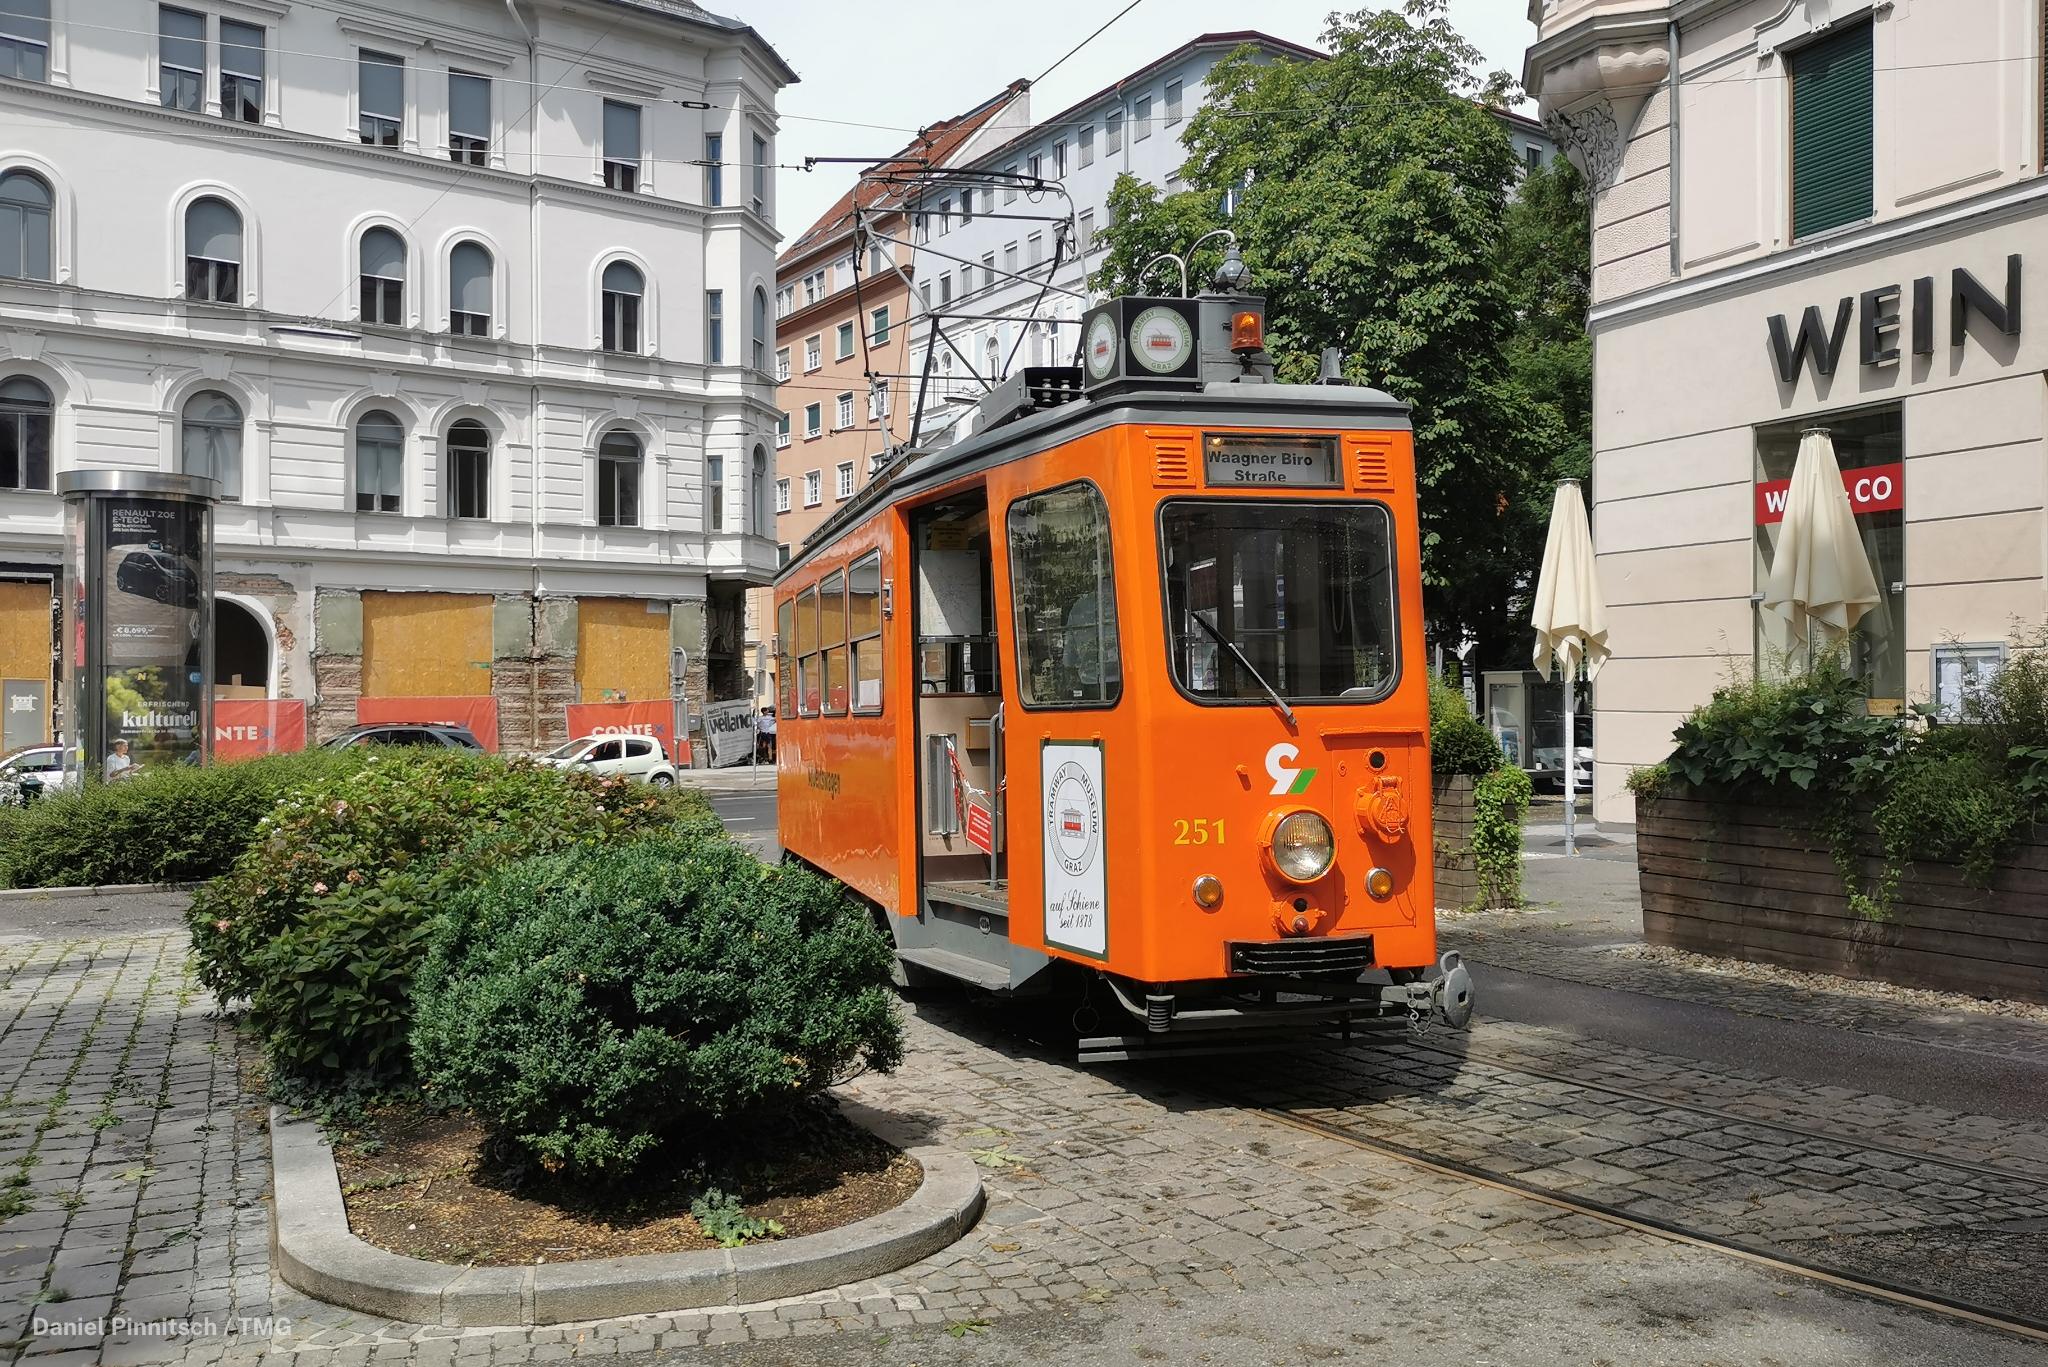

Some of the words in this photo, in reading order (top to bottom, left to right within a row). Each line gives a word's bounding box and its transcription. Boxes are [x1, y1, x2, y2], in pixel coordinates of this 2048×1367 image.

[1767, 254, 2022, 382] WEIN
[1133, 310, 1155, 344] TRAMWAY
[1173, 314, 1190, 347] MUSEUM
[1151, 362, 1173, 370] GRAZ
[1208, 451, 1277, 466] Waagner
[1281, 453, 1313, 466] Biro
[1234, 469, 1286, 482] Straße
[1855, 476, 1892, 503] CO
[112, 509, 157, 518] RENAULT
[157, 511, 176, 519] ZOE
[112, 516, 148, 524] E-TECH
[122, 710, 197, 727] kulturell
[215, 726, 258, 741] NTE
[591, 724, 653, 736] CONTE
[1049, 767, 1068, 824] TRAMWAY
[1080, 773, 1097, 834] MUSEUM
[1173, 818, 1226, 845] 251
[1064, 859, 1083, 873] GRAZ
[1050, 891, 1067, 919] auf
[1067, 889, 1100, 911] Schiene
[1060, 914, 1074, 928] seit
[1076, 914, 1092, 928] 1878
